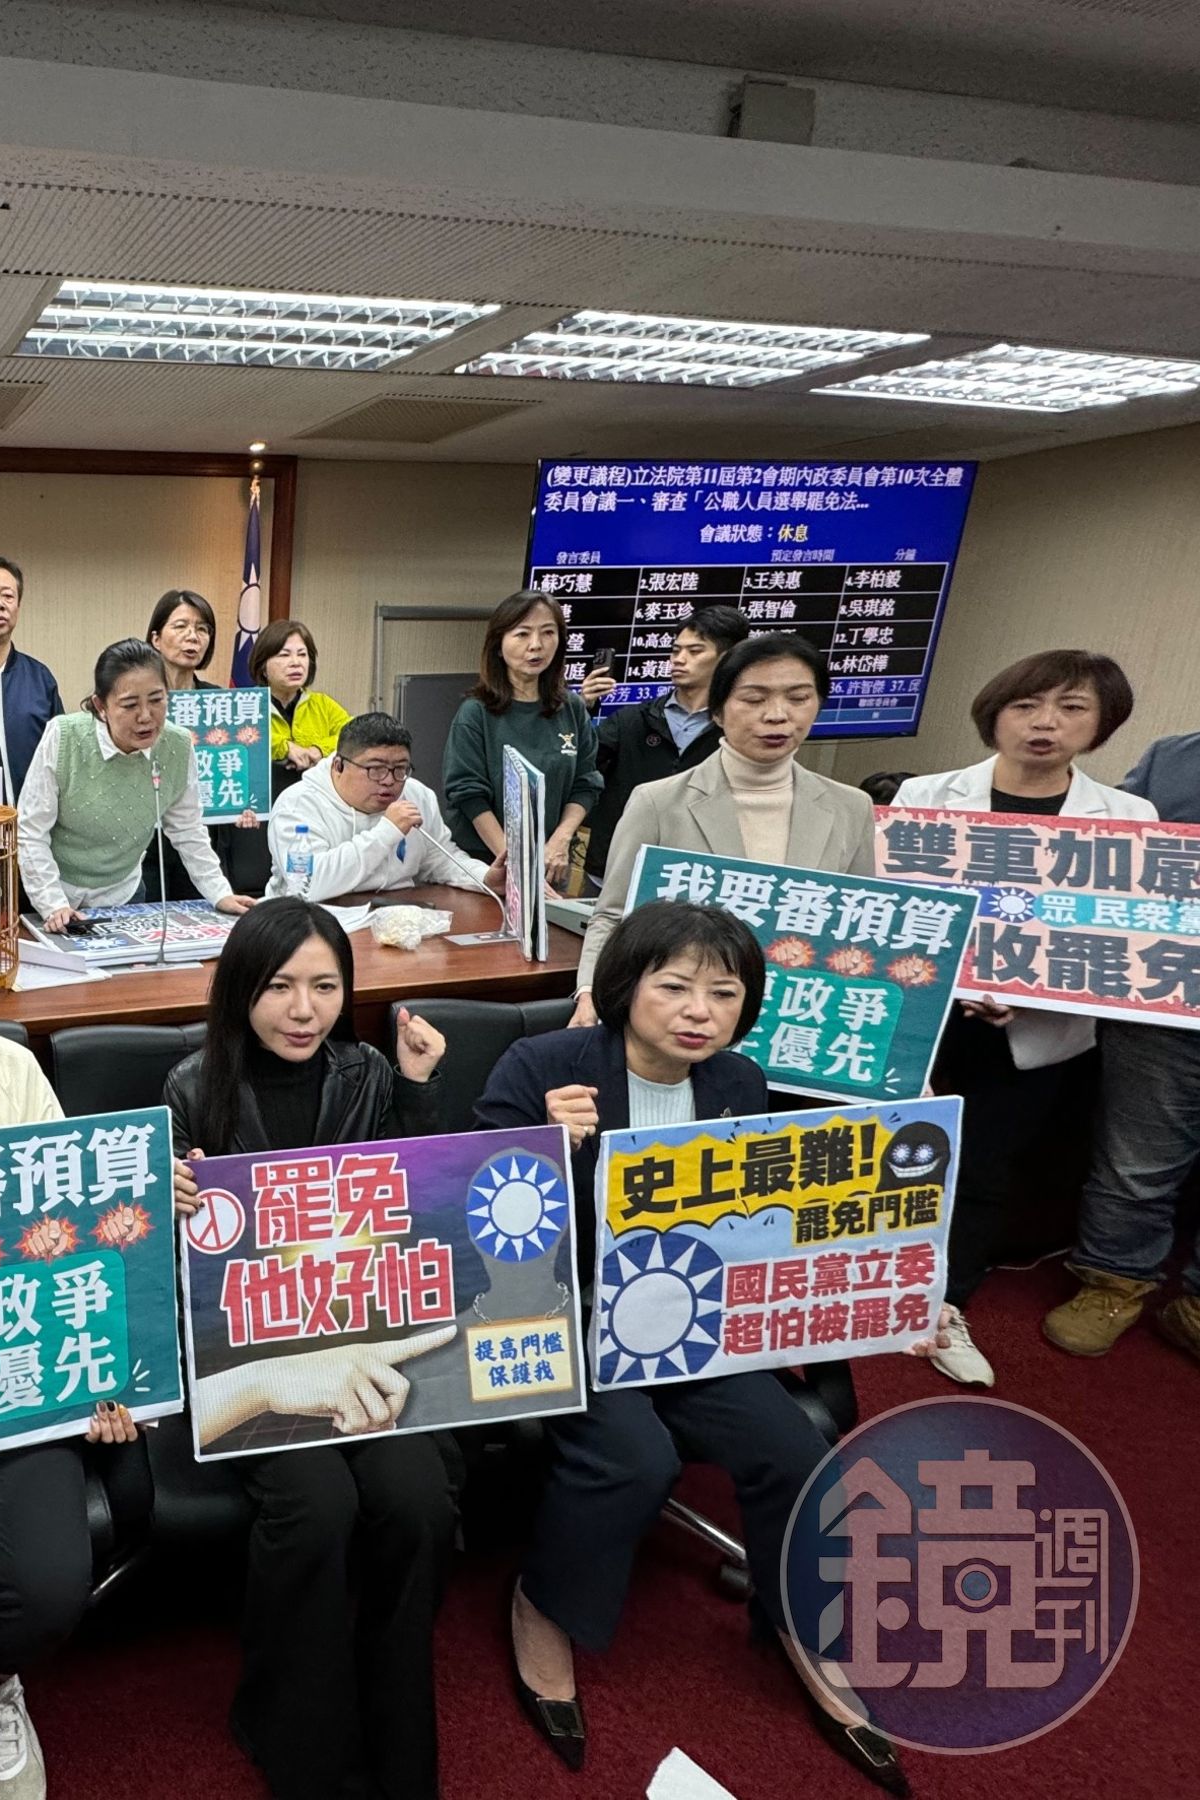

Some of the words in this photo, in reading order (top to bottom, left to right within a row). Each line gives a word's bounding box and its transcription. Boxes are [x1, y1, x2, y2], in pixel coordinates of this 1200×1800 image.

[640, 572, 699, 592] 2.張宏陸
[744, 571, 802, 589] 3.王美惠
[632, 633, 675, 649] 10.高金
[166, 692, 263, 726] 審預算
[620, 1123, 878, 1220] 史上最難!
[251, 1152, 412, 1250] 罷免
[795, 1189, 939, 1244] 罷免門檻
[220, 1238, 457, 1347] 他好怕
[725, 1243, 936, 1309] 國民黨立委
[723, 1293, 931, 1356] 超怕被罷免
[474, 1332, 565, 1362] 提高門檻
[488, 1359, 555, 1388] 保護我
